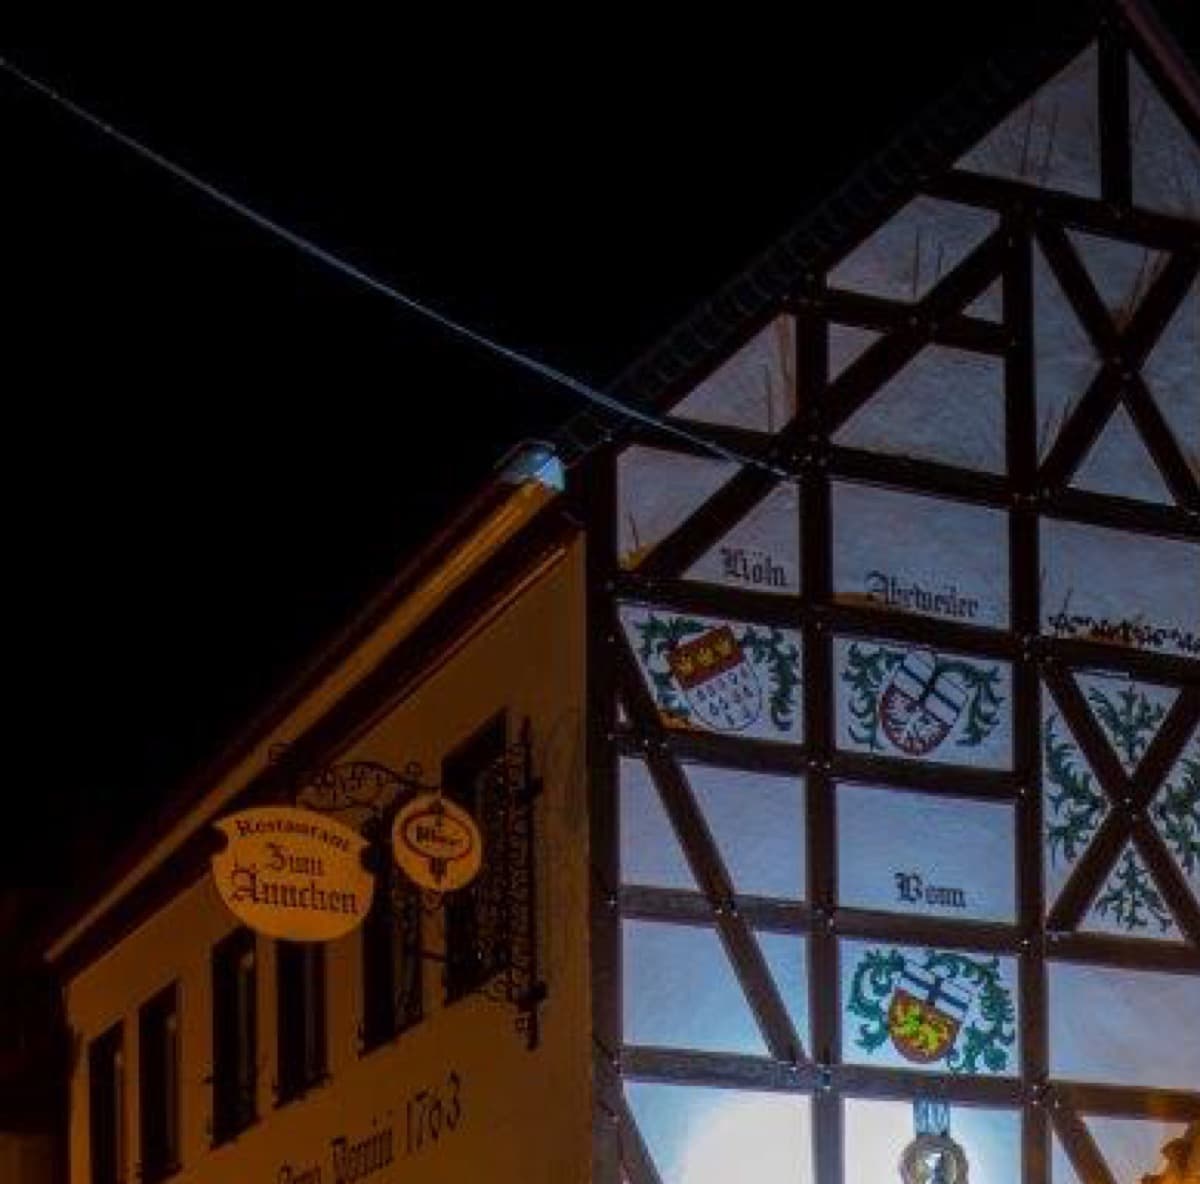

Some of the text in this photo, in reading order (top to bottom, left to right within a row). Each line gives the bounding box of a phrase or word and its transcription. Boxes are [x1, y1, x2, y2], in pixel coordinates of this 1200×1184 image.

[720, 545, 789, 587] Köln
[236, 819, 350, 852] Restaurant
[266, 841, 325, 876] Zum
[230, 861, 359, 914] Ännchen
[894, 872, 966, 908] Bonn
[405, 1070, 461, 1154] 1763
